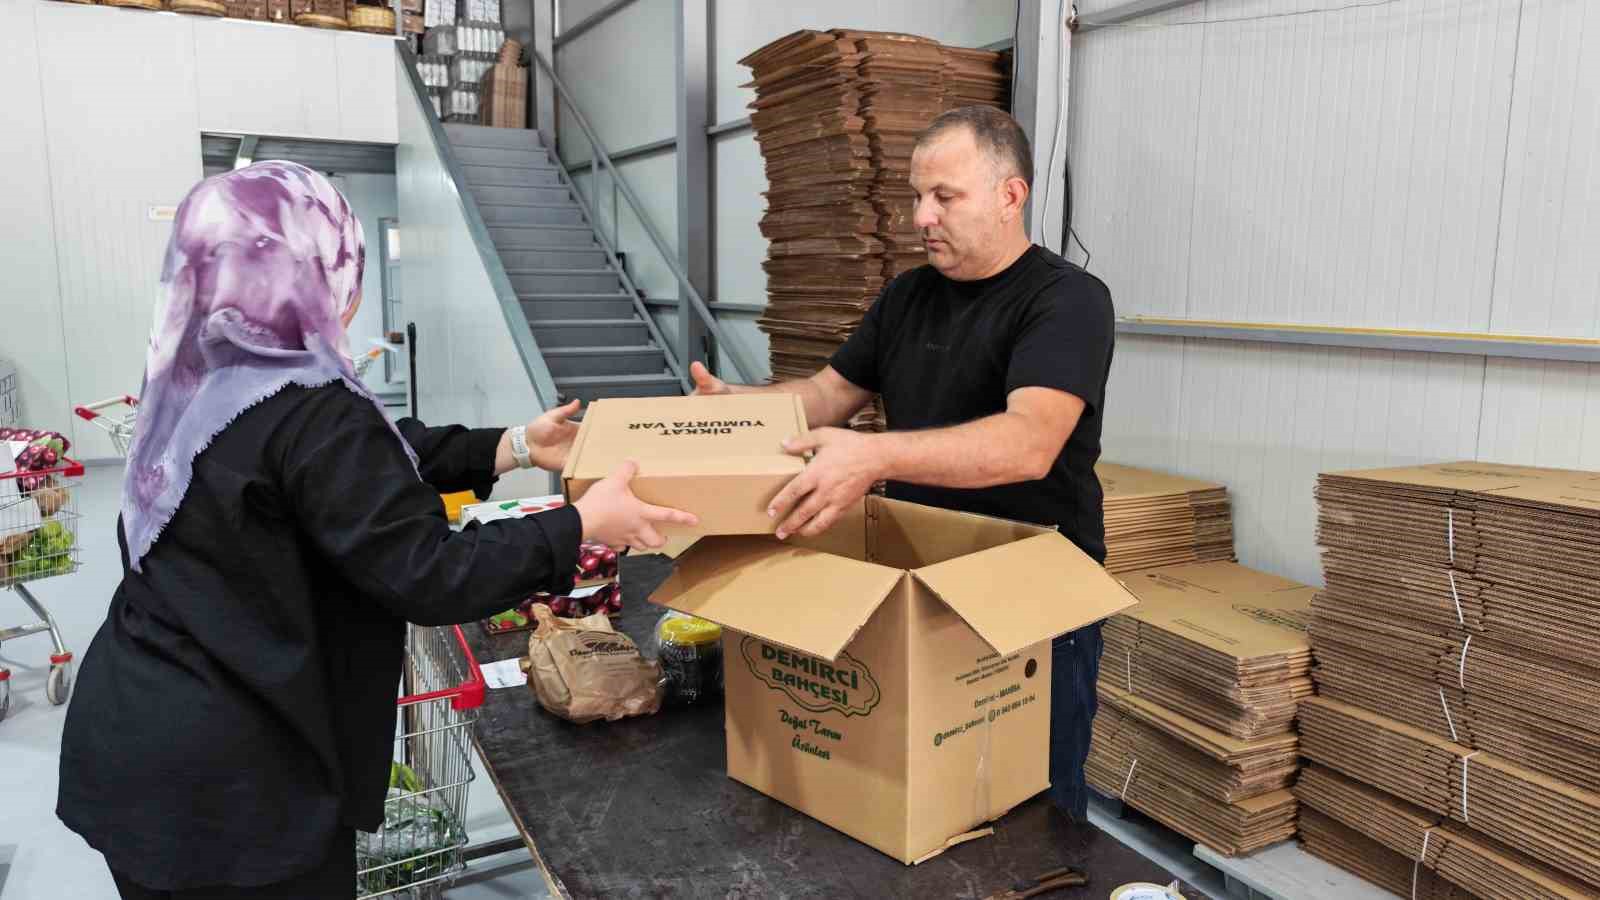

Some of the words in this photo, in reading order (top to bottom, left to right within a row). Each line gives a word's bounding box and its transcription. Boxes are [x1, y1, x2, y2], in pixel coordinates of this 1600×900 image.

[628, 422, 666, 430] VAR
[673, 420, 765, 428] YUMURTA
[660, 428, 732, 436] DİKKAT
[771, 667, 848, 706] BAHÇESİ
